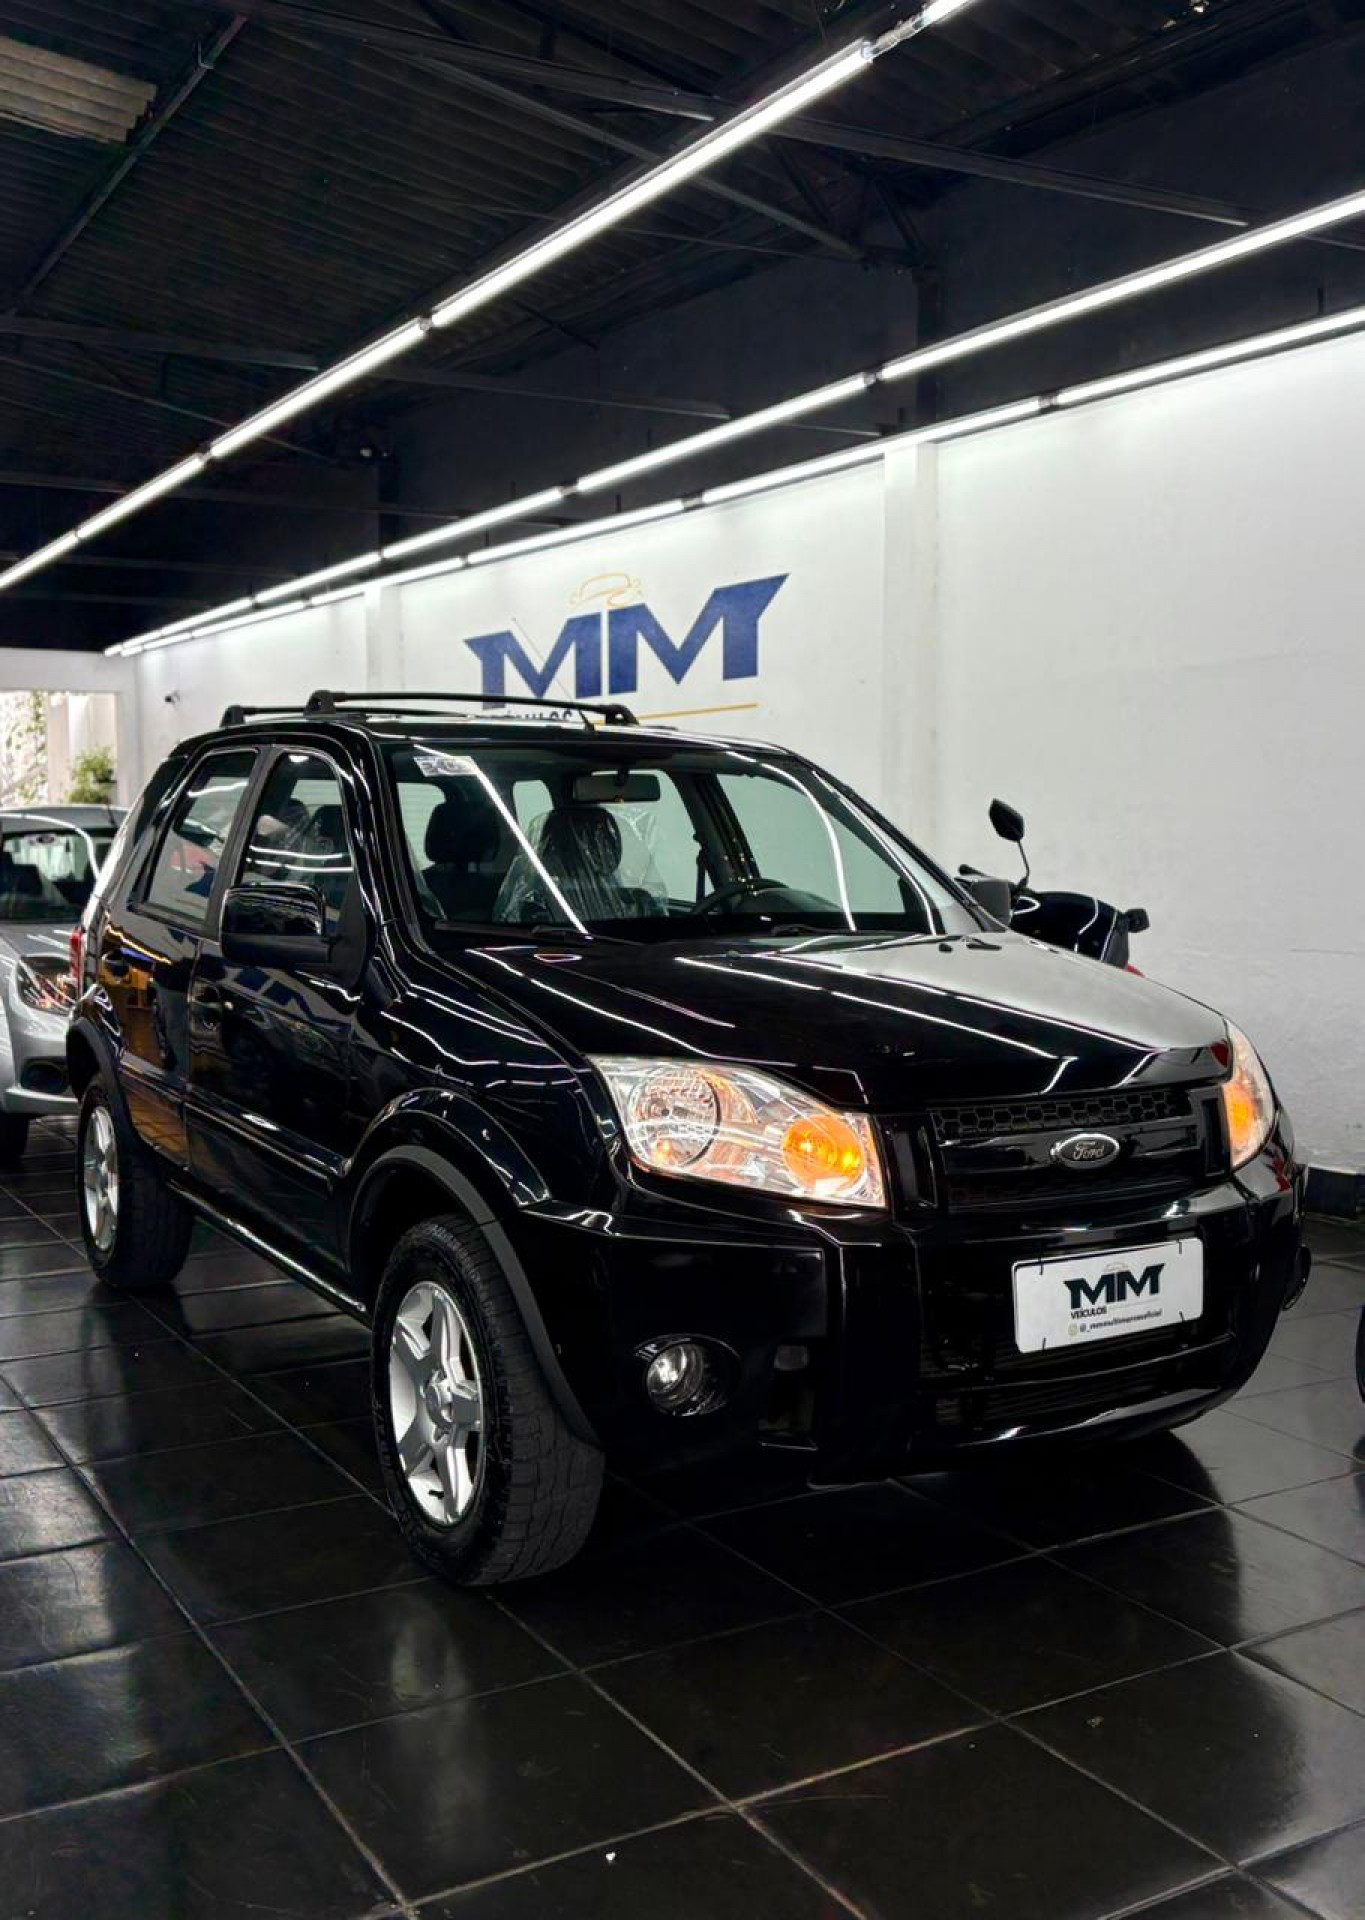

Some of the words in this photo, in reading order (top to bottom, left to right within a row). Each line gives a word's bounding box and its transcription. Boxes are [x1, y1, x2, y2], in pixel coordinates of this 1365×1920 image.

[463, 573, 789, 710] MM
[1073, 1141, 1105, 1160] Ford
[1064, 1263, 1165, 1309] MM
